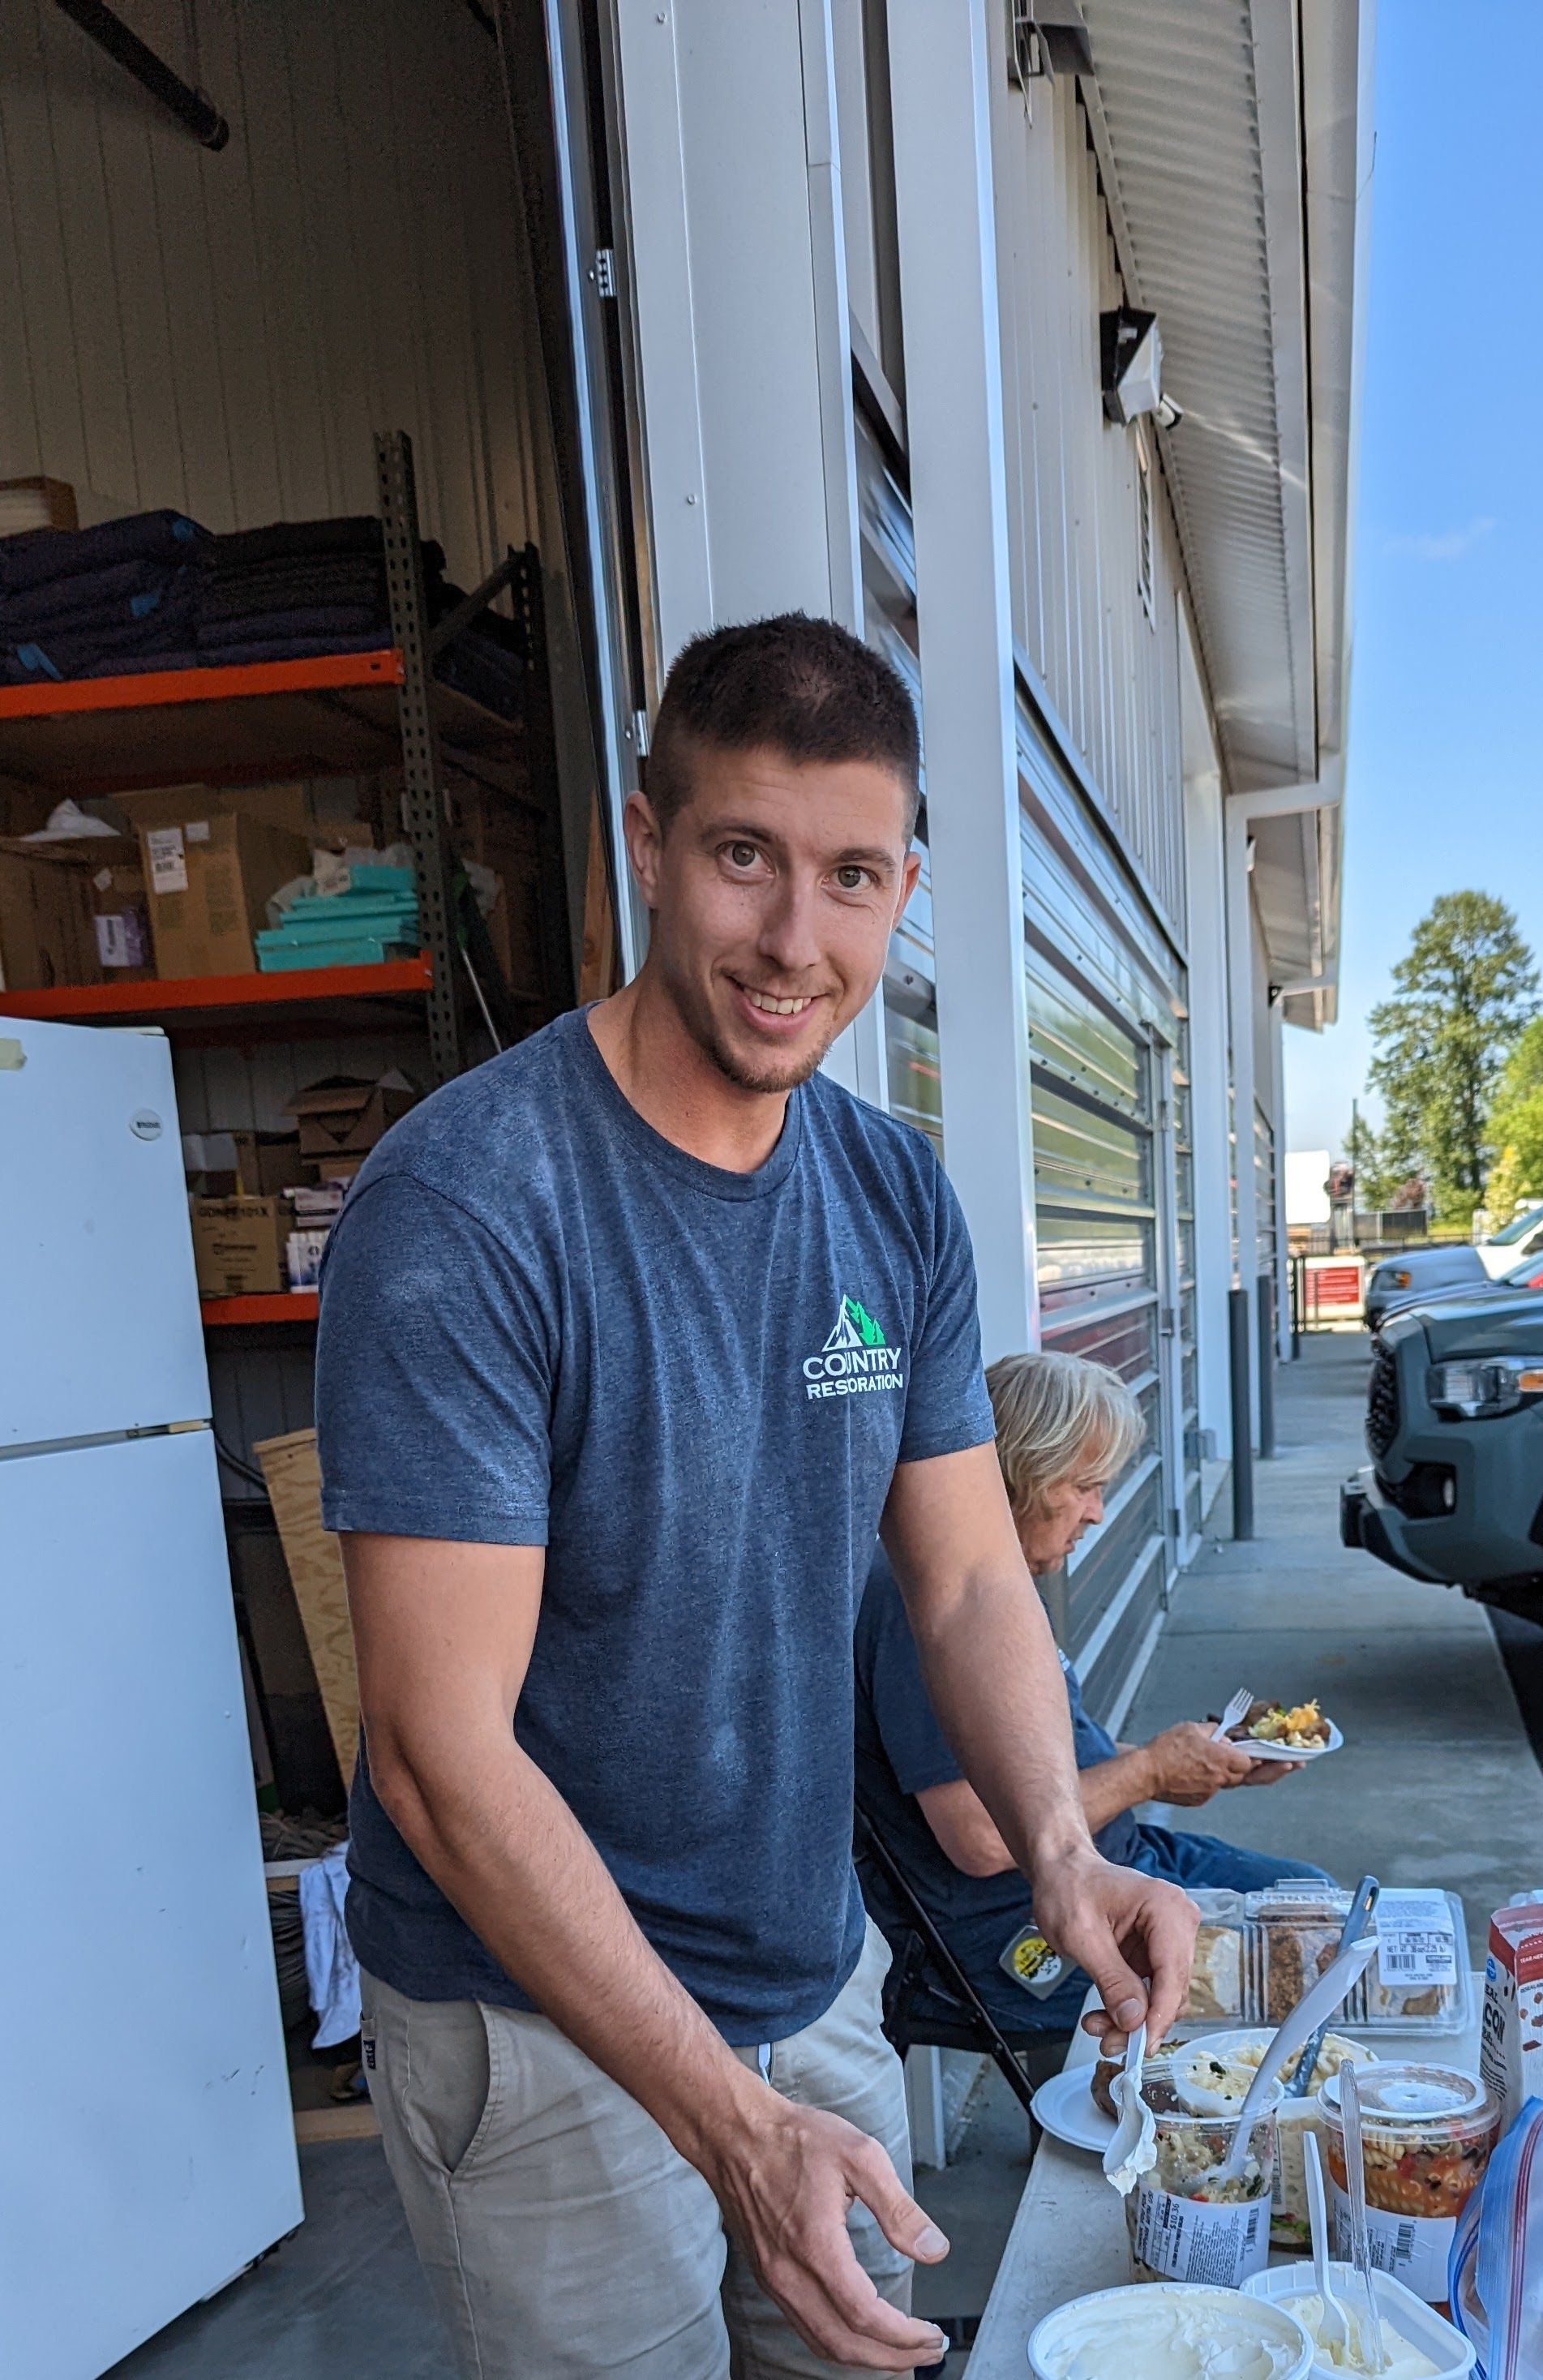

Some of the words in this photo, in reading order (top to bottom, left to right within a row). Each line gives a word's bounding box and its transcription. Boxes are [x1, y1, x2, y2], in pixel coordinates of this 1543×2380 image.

[803, 1348, 902, 1379] COUNTRY
[1485, 1983, 1498, 2004] EAL
[1483, 2002, 1505, 2044] CON
